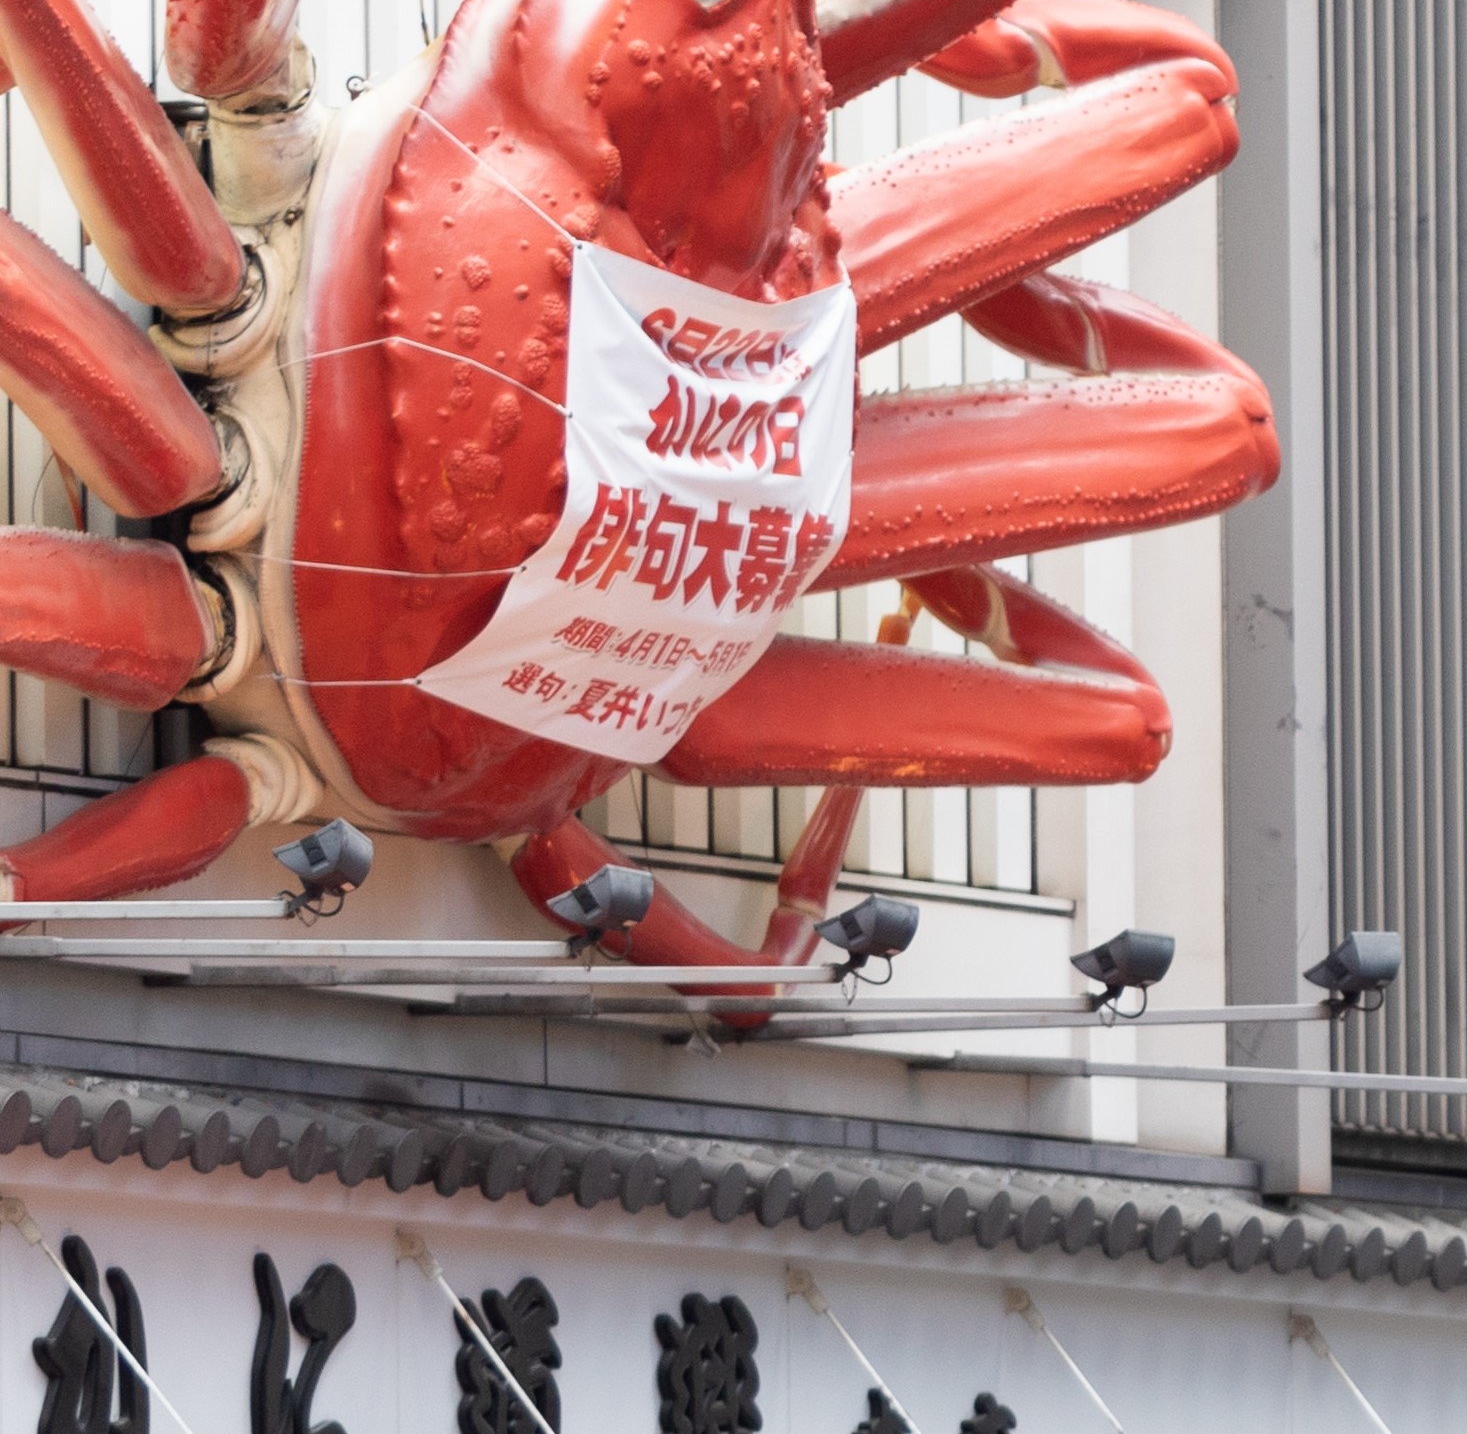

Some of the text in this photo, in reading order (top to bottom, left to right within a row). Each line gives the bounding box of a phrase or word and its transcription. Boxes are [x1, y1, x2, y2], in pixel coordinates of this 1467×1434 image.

[645, 374, 806, 478] かにの日
[556, 482, 836, 616] 俳句大募集
